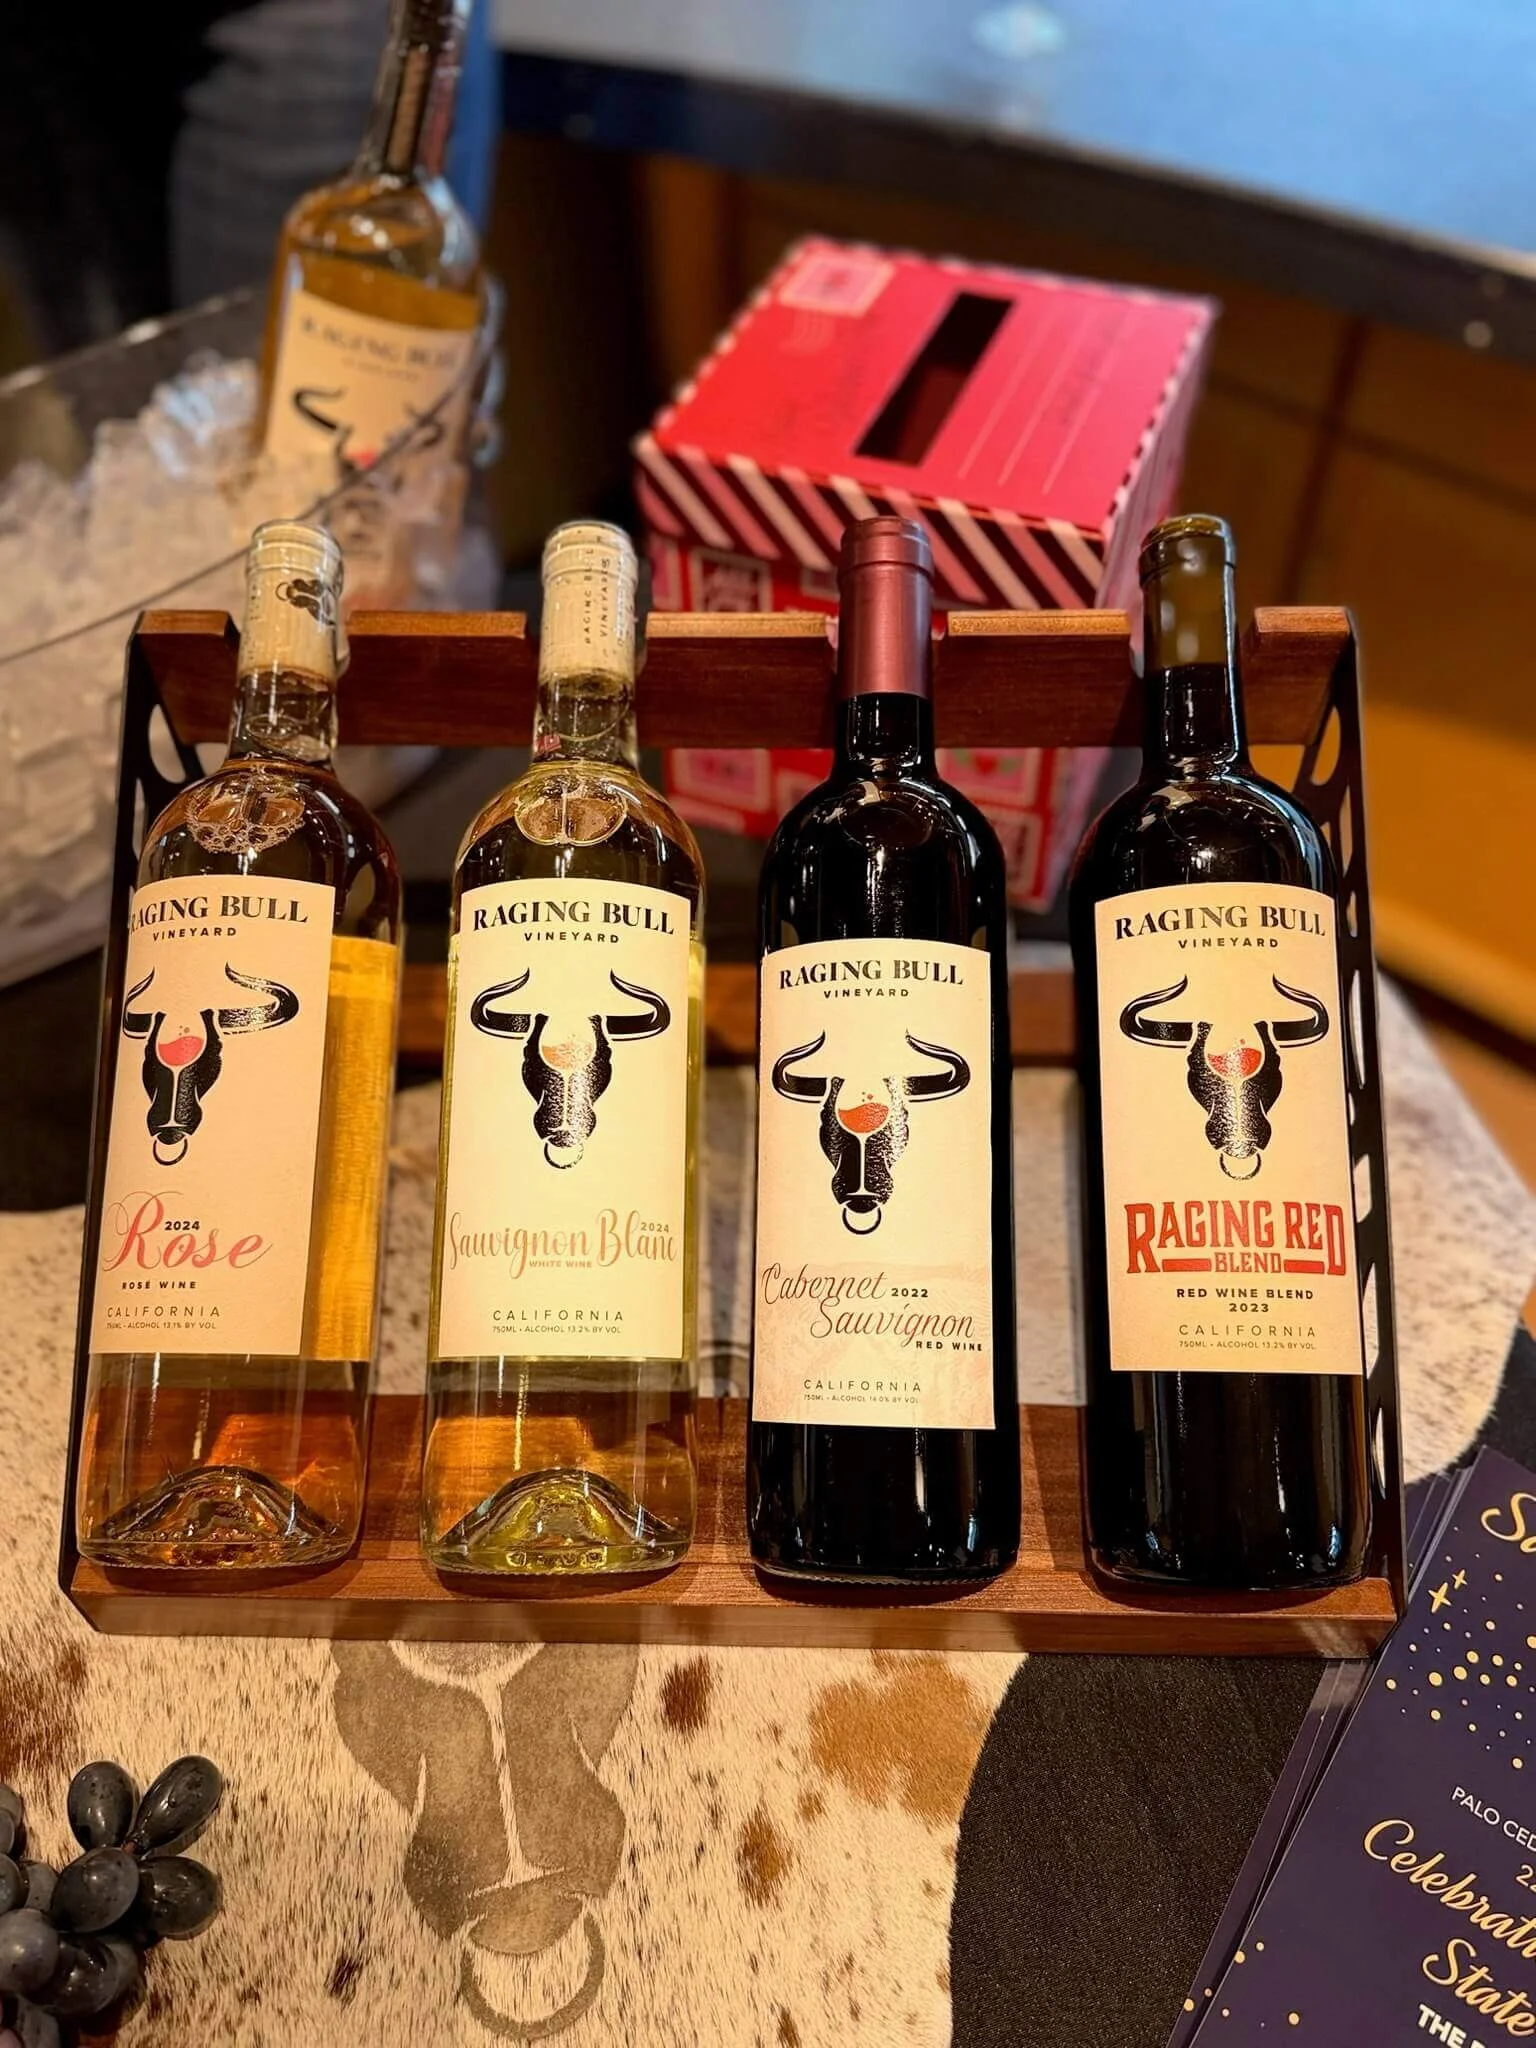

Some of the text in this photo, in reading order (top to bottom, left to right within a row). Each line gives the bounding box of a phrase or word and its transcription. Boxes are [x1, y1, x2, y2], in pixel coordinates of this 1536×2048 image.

[219, 895, 309, 923] BULL
[472, 900, 675, 935] RAGING BULL
[1115, 905, 1326, 941] RAGING BULL
[152, 927, 237, 941] VINEYARD
[523, 931, 620, 944] VINEYARD
[1178, 937, 1280, 949] VINEYARD
[779, 959, 964, 990] RAGING BULL
[823, 988, 910, 999] VINEYARD
[102, 1190, 274, 1272] Rose
[164, 1220, 201, 1231] 2024
[640, 1221, 670, 1233] 2024
[449, 1208, 678, 1280] Sauvignon Blanc
[1123, 1200, 1347, 1276] RAGING RED
[529, 1260, 592, 1269] WHITE WINE
[1213, 1251, 1282, 1274] BLEND
[159, 1281, 197, 1289] WINE
[761, 1262, 929, 1305] Cabernet 2022
[1176, 1288, 1314, 1300] RED WINE BLEND
[107, 1306, 220, 1318] CALIFORNIA
[1228, 1302, 1270, 1313] 2023
[492, 1310, 624, 1321] CALIFORNIA
[810, 1297, 976, 1347] Sauvignon
[127, 1321, 160, 1329] ALCOHOL
[184, 1321, 196, 1329] BY
[492, 1325, 517, 1334] 750ML
[524, 1325, 565, 1333] ALCOHOL
[1179, 1324, 1316, 1338] CALIFORNIA
[915, 1340, 984, 1351] RED WINE
[1216, 1340, 1259, 1348] ALCOHOL
[803, 1379, 921, 1393] CALIFORNIA
[831, 1394, 867, 1402] ALCOHOL
[1451, 1786, 1501, 1826] PALO
[1422, 1938, 1536, 2037] State
[1417, 2003, 1468, 2048] THE
